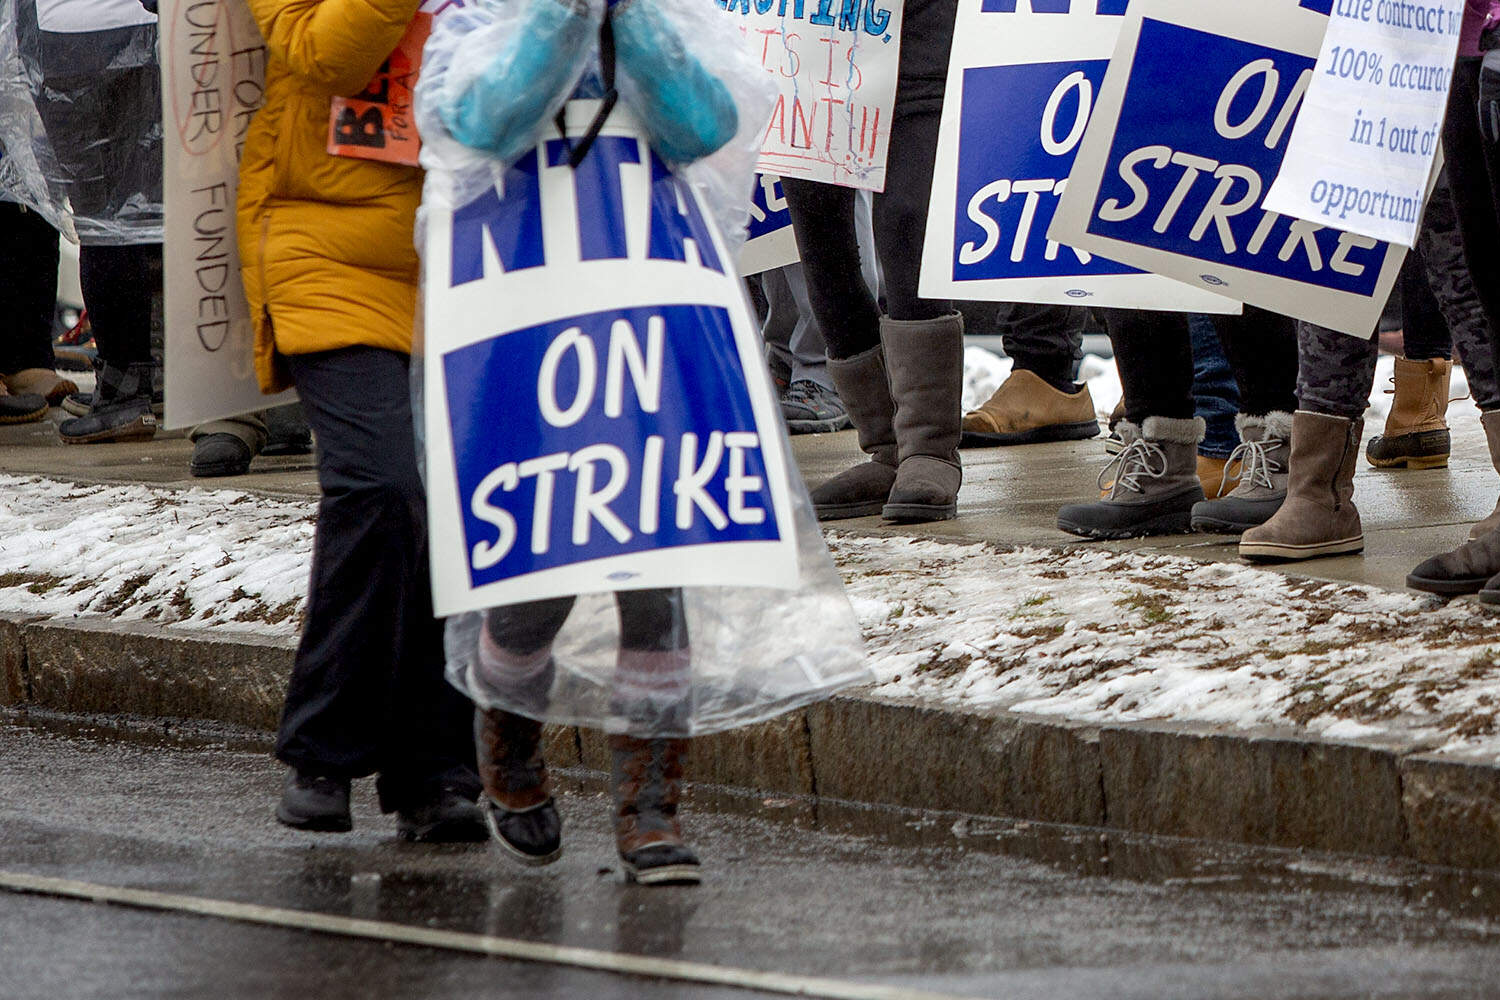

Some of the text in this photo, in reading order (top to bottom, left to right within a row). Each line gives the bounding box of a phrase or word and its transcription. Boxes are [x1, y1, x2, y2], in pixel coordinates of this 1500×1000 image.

[819, 37, 862, 92] IS
[1326, 45, 1383, 86] 100%
[184, 1, 229, 353] UNDER FUNDED
[1350, 109, 1374, 145] in
[1376, 117, 1387, 148] 1
[1389, 125, 1418, 155] out
[450, 136, 725, 288] NTA
[539, 315, 664, 428] ON
[470, 432, 767, 572] STRIKE
